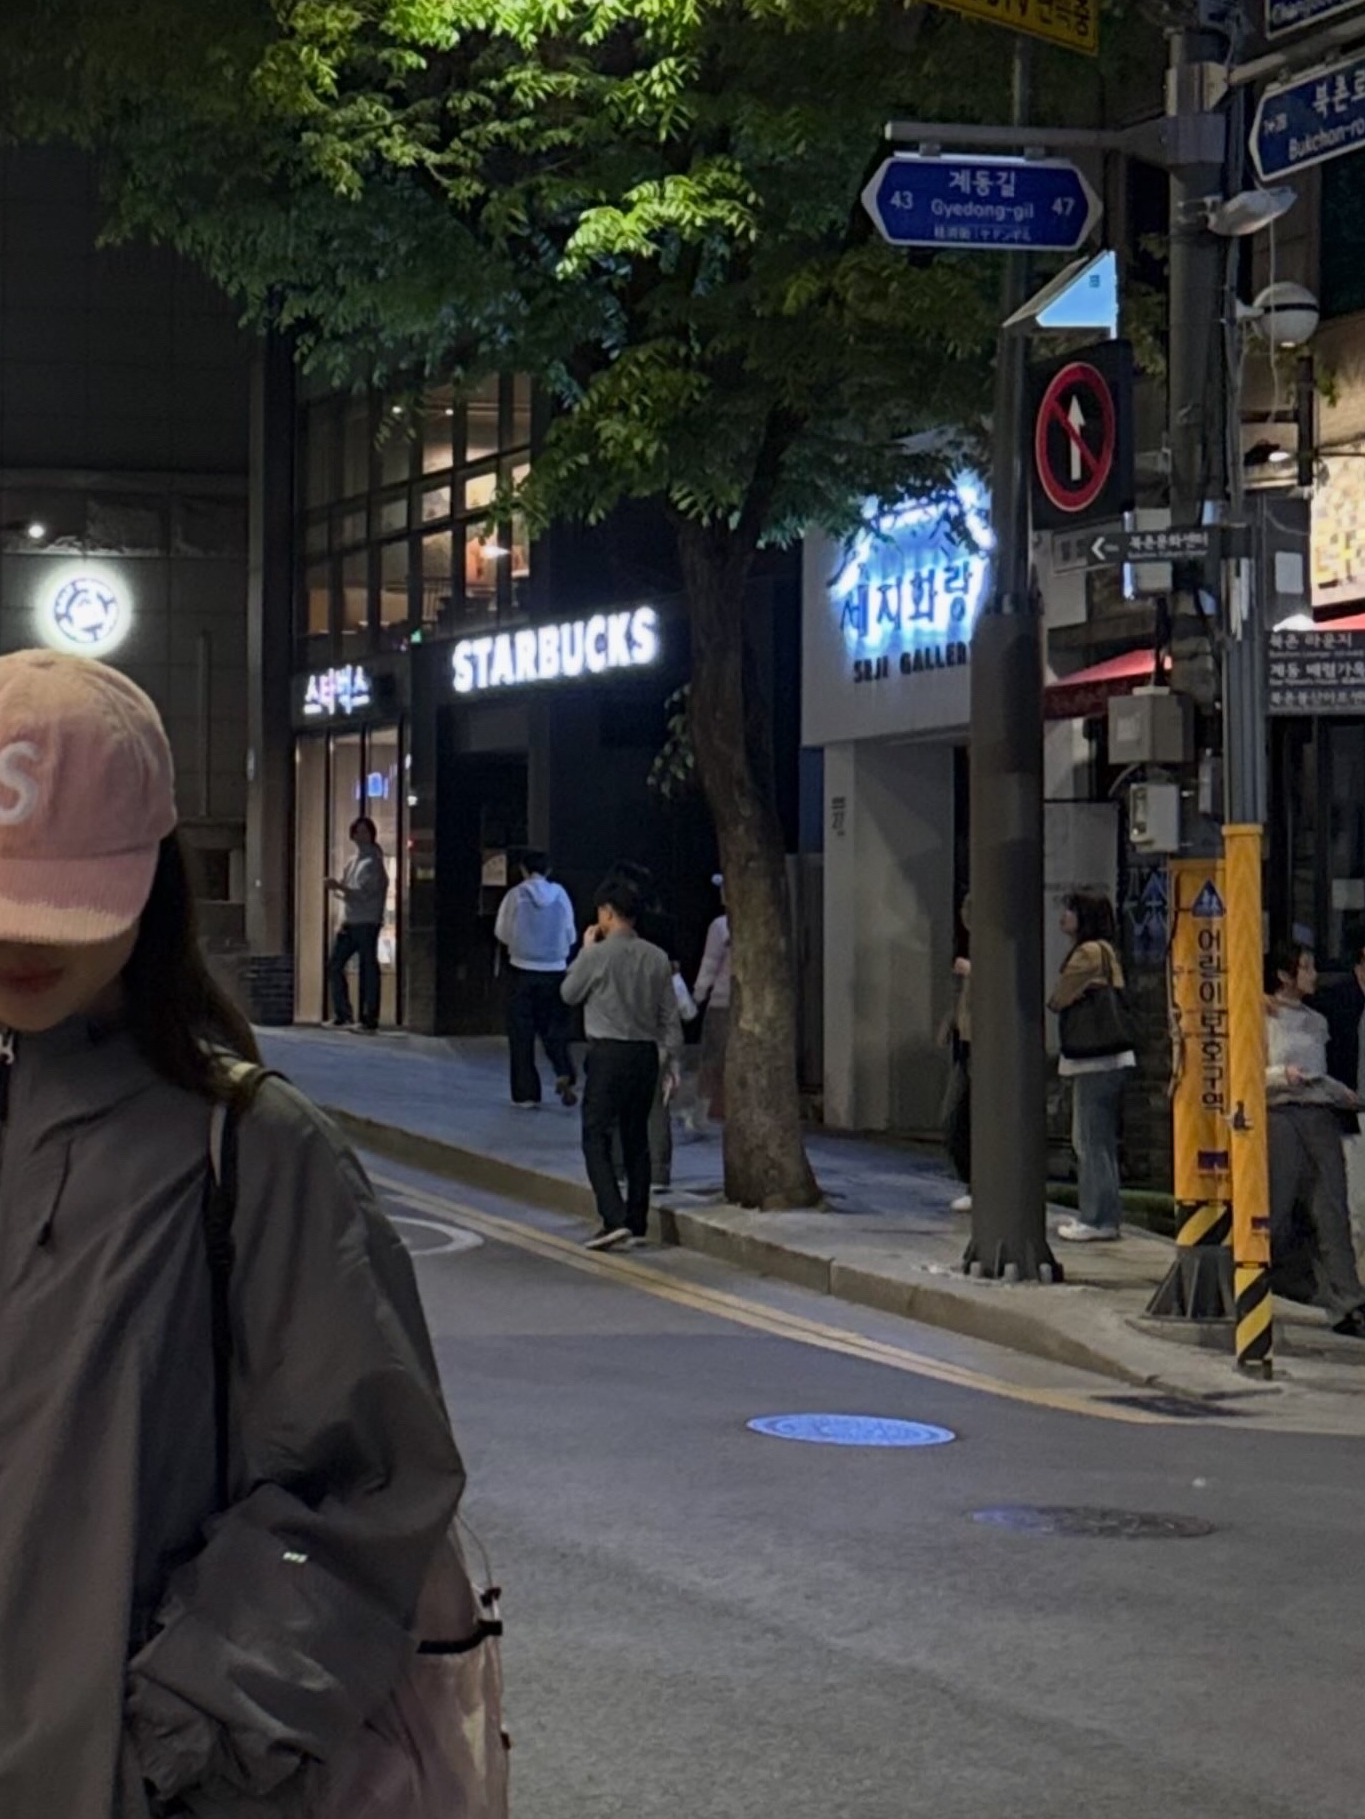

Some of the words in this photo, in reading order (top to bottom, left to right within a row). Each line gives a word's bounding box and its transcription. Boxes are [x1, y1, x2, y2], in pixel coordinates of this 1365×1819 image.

[949, 168, 1016, 198] 계동길
[890, 190, 913, 209] 43
[931, 199, 1034, 222] Gyedong-gil
[1052, 196, 1075, 216] 47
[452, 605, 660, 694] STARBUCKS
[899, 641, 968, 675] GALLER
